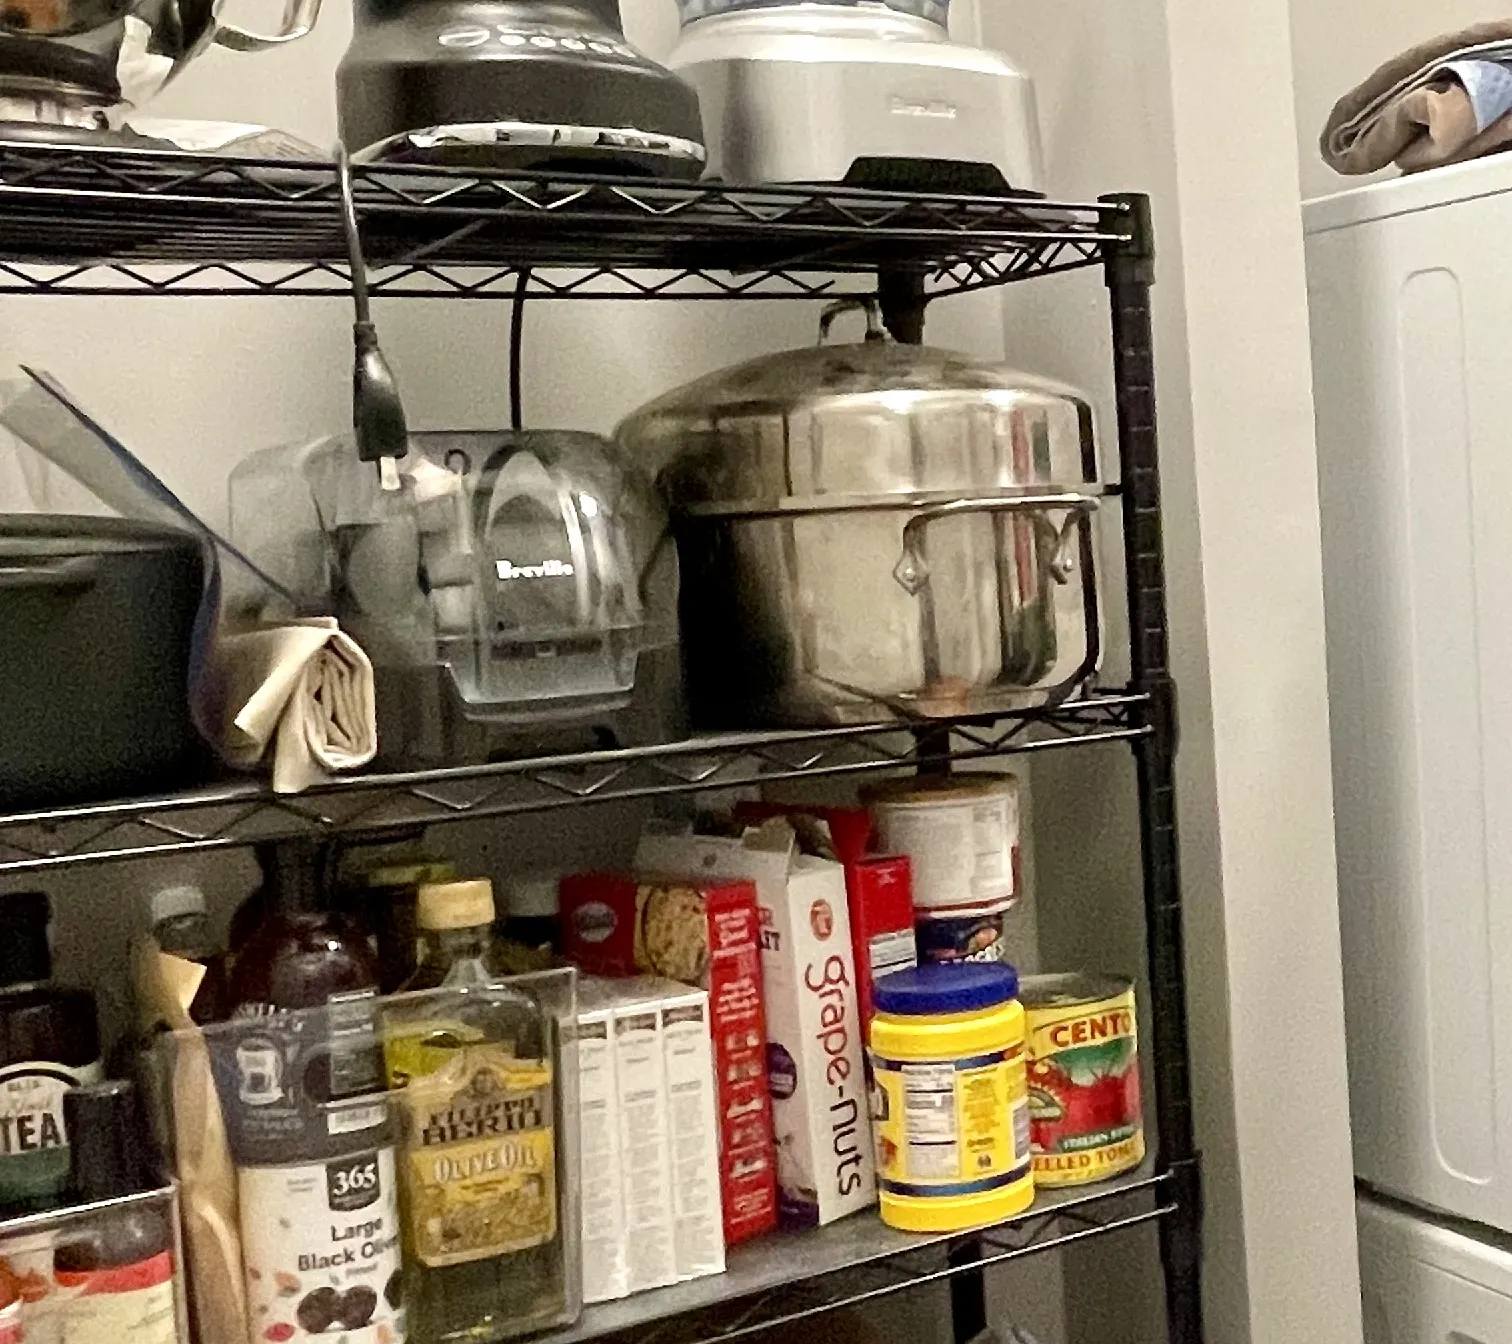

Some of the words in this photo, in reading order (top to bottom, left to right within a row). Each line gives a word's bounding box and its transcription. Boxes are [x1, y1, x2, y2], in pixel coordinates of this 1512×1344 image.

[1049, 1012, 1132, 1047] CENTO
[804, 954, 862, 1197] grape-nuts
[332, 1162, 377, 1197] 365
[330, 1216, 383, 1242] Large
[297, 1246, 356, 1272] Black
